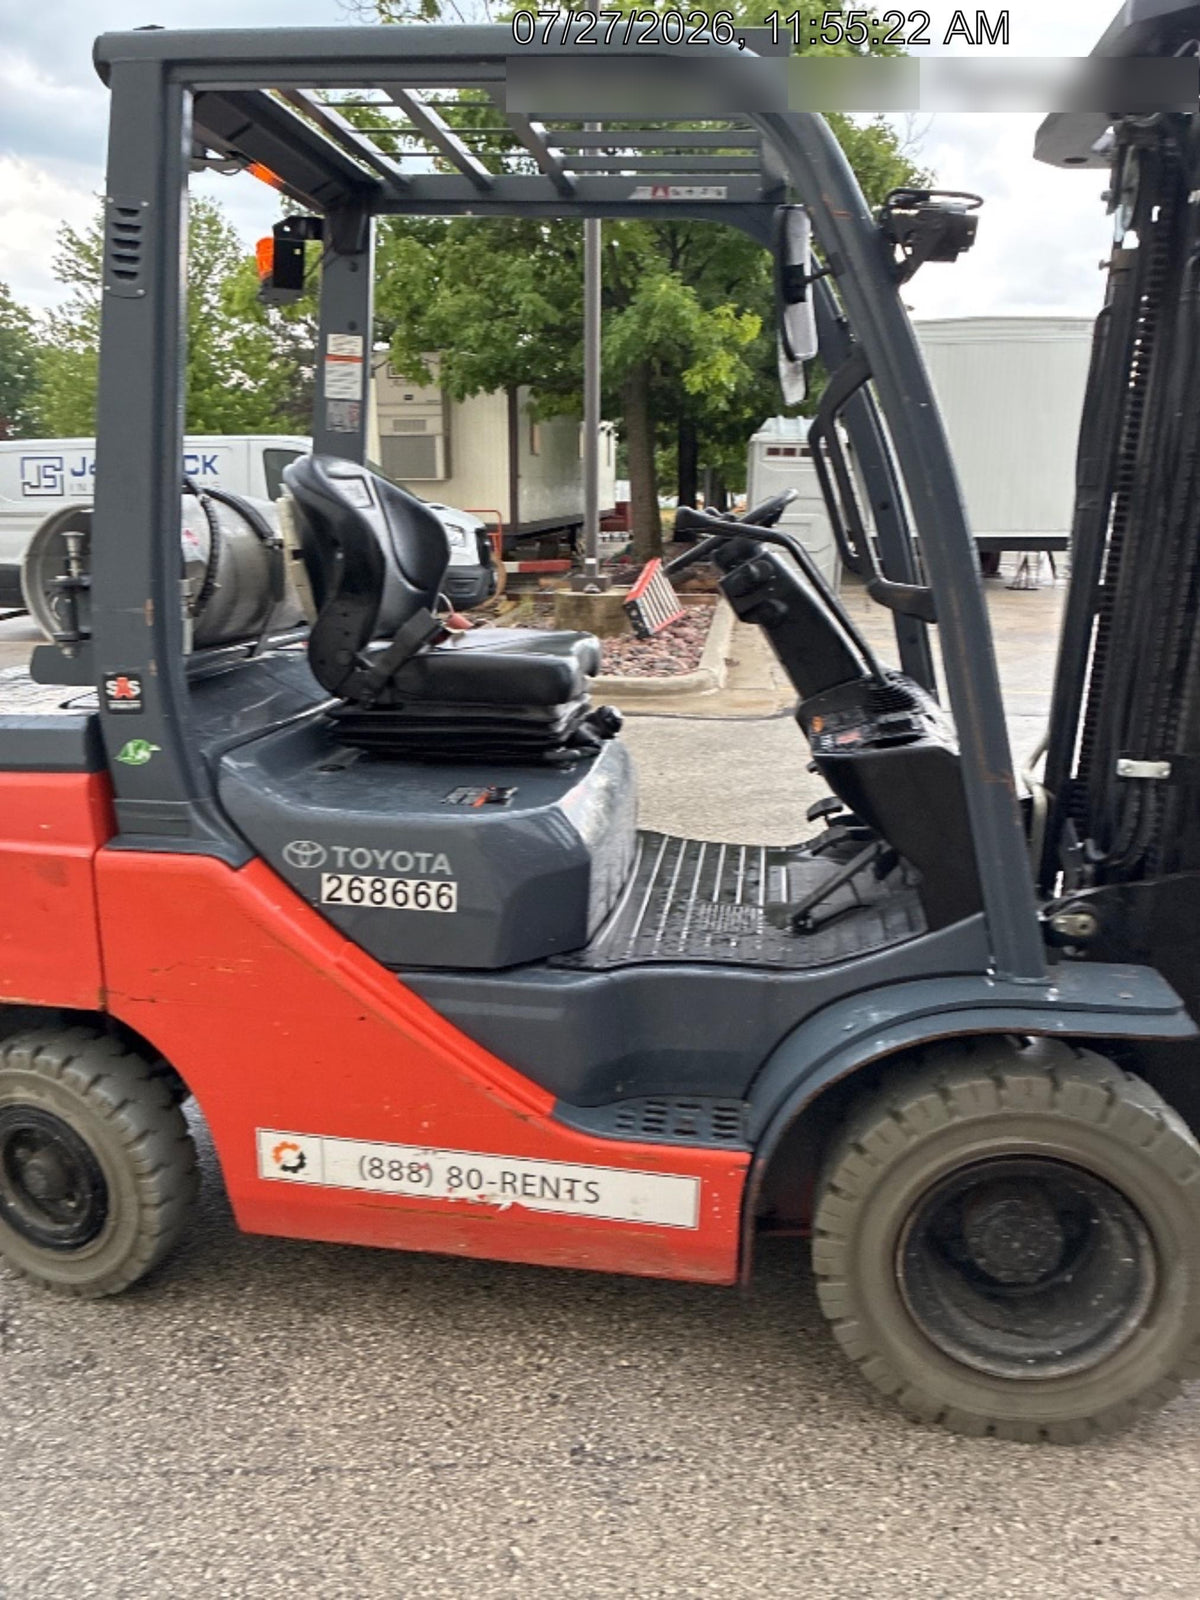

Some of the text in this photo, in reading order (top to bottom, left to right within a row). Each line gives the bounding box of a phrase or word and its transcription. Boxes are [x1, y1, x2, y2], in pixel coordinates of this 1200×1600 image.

[330, 846, 454, 876] TOYOTA
[325, 875, 453, 911] 268666
[359, 1155, 600, 1204] (888) 80-RENTS
